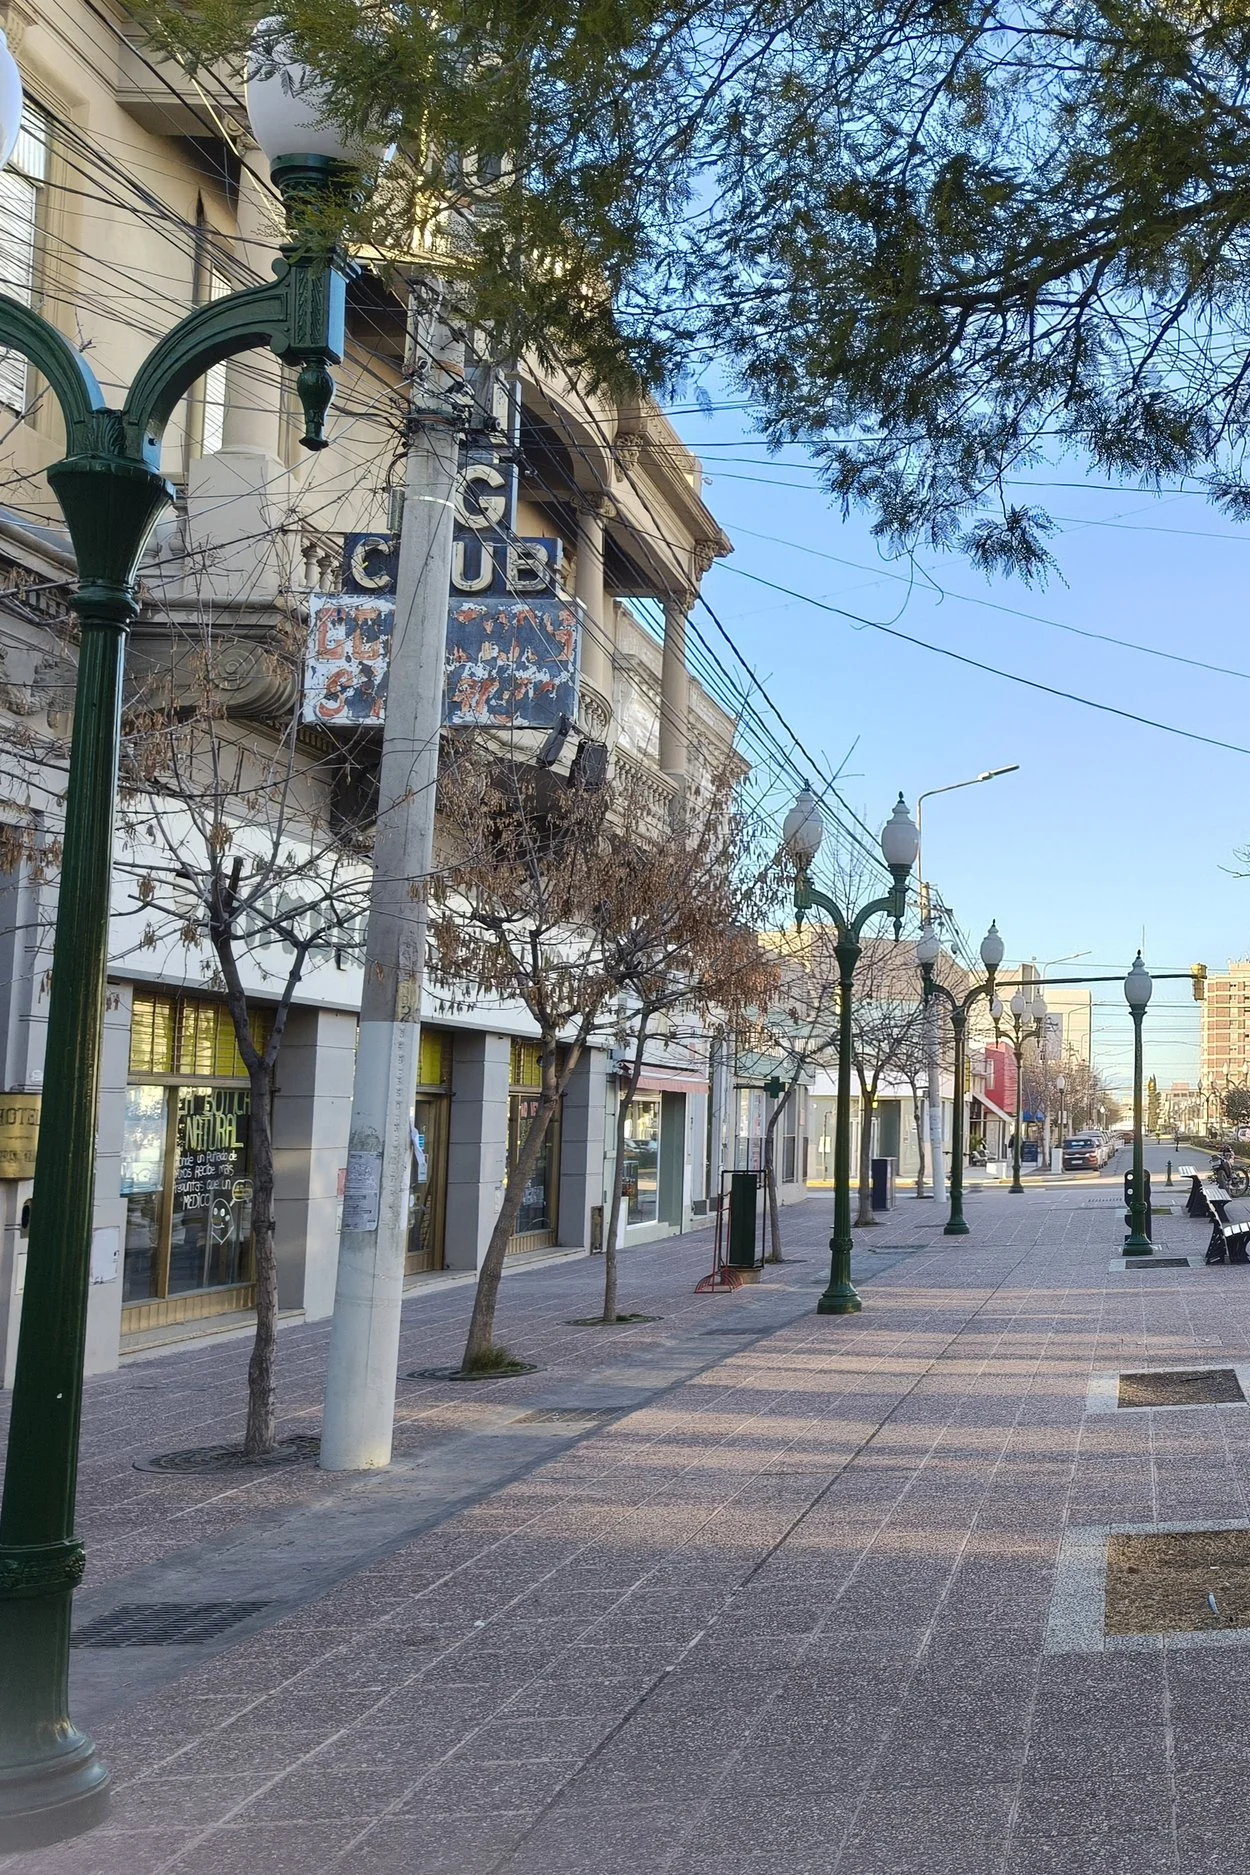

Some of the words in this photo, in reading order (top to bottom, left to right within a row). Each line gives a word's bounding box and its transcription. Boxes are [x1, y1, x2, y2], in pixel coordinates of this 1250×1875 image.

[350, 536, 549, 592] CUB
[185, 1113, 244, 1150] NATURAL
[229, 1150, 238, 1161] de
